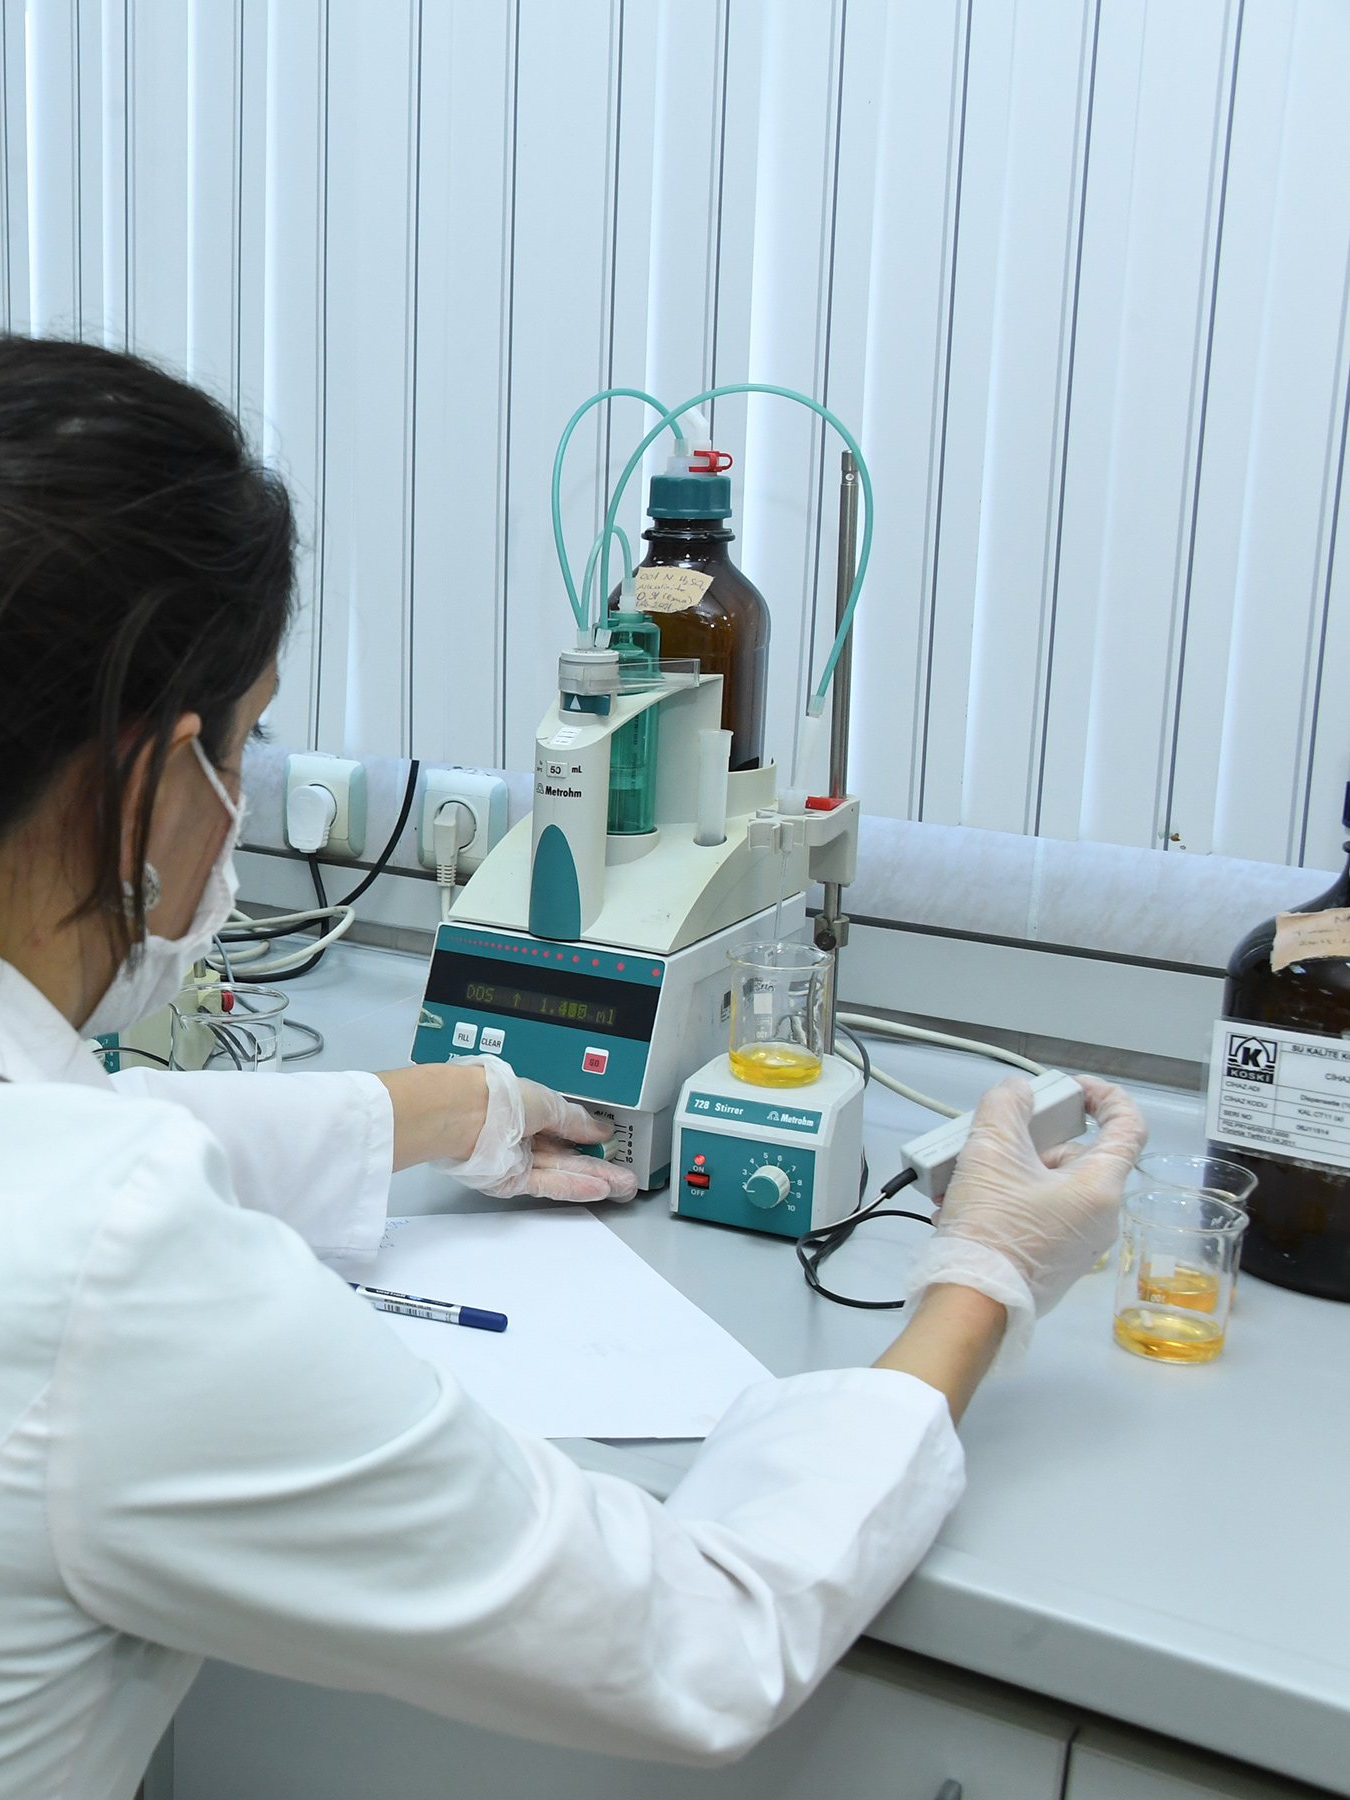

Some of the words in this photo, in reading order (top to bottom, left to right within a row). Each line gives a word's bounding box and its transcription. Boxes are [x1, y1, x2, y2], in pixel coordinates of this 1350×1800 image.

[663, 573, 674, 581] N
[545, 785, 582, 798] Metrohm
[466, 983, 495, 1003] DOS
[595, 1008, 616, 1025] ml
[457, 1032, 470, 1043] FILL
[481, 1036, 501, 1048] CLEAR
[1292, 1044, 1304, 1053] SU
[588, 1058, 600, 1068] GO
[693, 1098, 710, 1111] 728
[714, 1102, 745, 1116] Stirrer
[780, 1113, 814, 1128] Metrohm
[625, 1156, 634, 1164] 10
[749, 1157, 755, 1165] 4
[693, 1165, 705, 1173] ON
[791, 1165, 797, 1173] 7
[690, 1188, 705, 1197] OFF
[787, 1204, 796, 1212] 10
